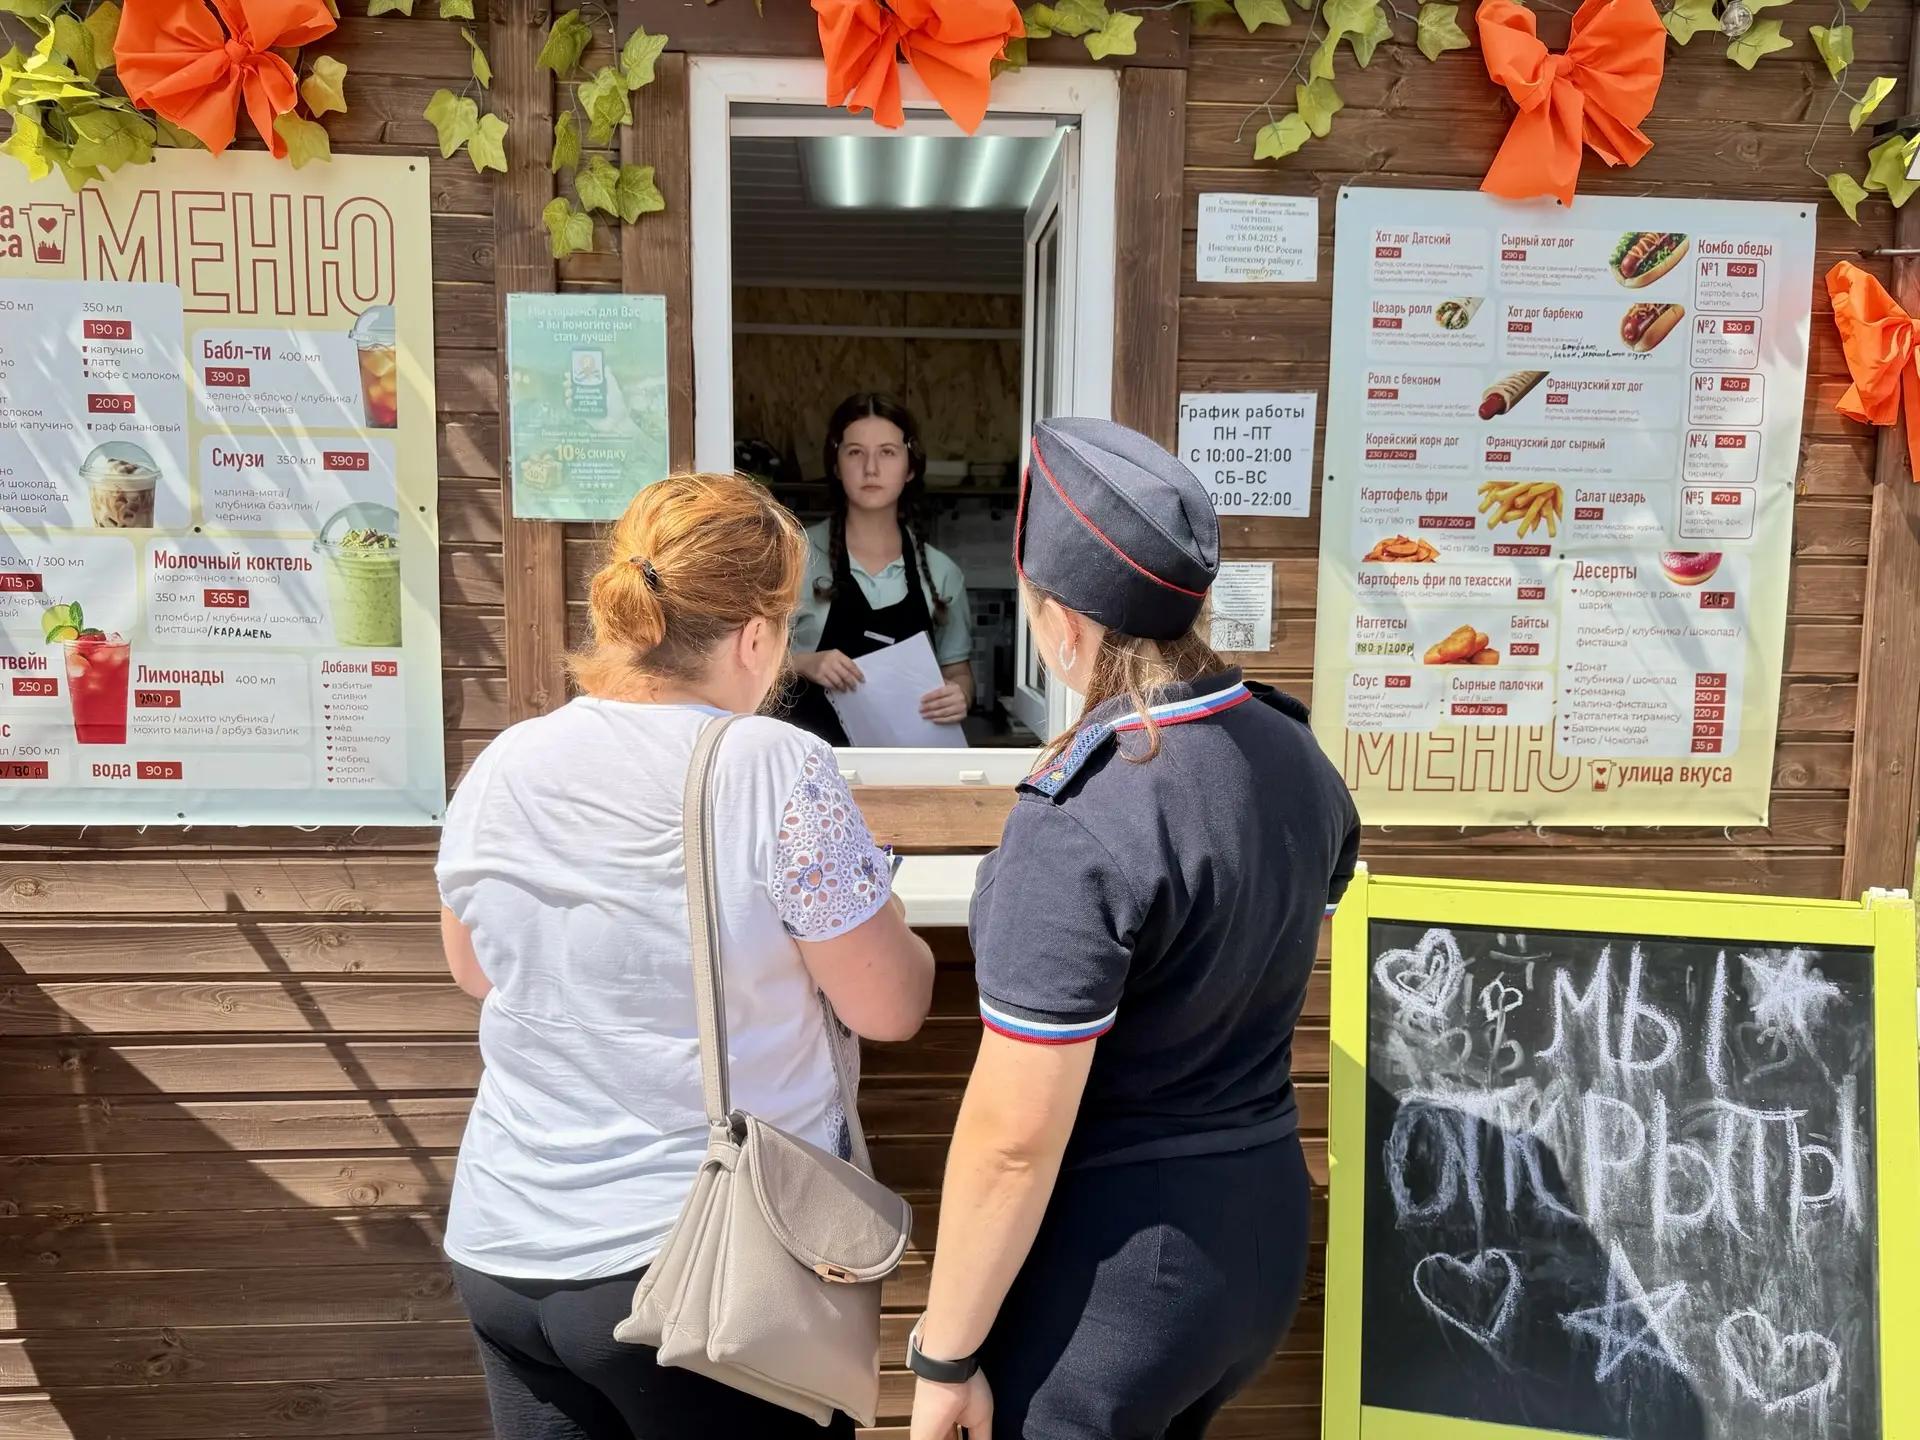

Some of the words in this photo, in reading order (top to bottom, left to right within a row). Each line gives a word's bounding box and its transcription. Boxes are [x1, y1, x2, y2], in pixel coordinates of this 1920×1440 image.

[1375, 230, 1391, 242] Хот
[1411, 232, 1451, 246] Датский
[1501, 233, 1539, 248] Сырный
[1541, 238, 1555, 247] хот
[1558, 238, 1574, 249] дог
[79, 187, 396, 316] МЕНЮ
[1698, 240, 1734, 255] Комбо
[1737, 241, 1773, 257] обеды
[1700, 262, 1719, 277] №1
[1730, 266, 1746, 275] 450
[83, 303, 103, 312] 350
[621, 306, 640, 317] Вас
[1372, 301, 1406, 315] Цезарь
[1408, 305, 1432, 316] ролл
[1507, 305, 1523, 317] Хот
[1525, 309, 1541, 320] дог
[1543, 306, 1583, 322] барбекю
[91, 324, 112, 334] 190
[563, 321, 610, 330] помогите
[1696, 319, 1716, 334] №2
[1726, 322, 1742, 332] 320
[554, 333, 578, 341] стать
[91, 347, 143, 355] капучино
[204, 340, 271, 361] Бабл-ти
[279, 352, 301, 362] 400
[305, 354, 320, 362] мл
[92, 370, 120, 380] кофе
[132, 372, 180, 380] молоком
[211, 372, 233, 382] 390
[1368, 372, 1391, 385] Ролл
[1401, 373, 1441, 385] беконом
[1546, 378, 1610, 393] Французский
[1611, 381, 1626, 391] хот
[1627, 382, 1644, 393] дог
[1694, 376, 1714, 391] №3
[1723, 380, 1739, 389] 420
[254, 392, 292, 402] яблоко
[301, 394, 351, 404] клубника
[96, 399, 119, 409] 200
[206, 405, 239, 413] манго
[248, 406, 294, 415] черника
[1180, 404, 1240, 422] График
[1246, 404, 1305, 422] работы
[21, 422, 73, 431] капучино
[95, 423, 117, 433] раф
[120, 422, 181, 432] банановый
[1213, 426, 1237, 441] ПН
[1366, 433, 1417, 447] Корейский
[1420, 436, 1441, 448] корн
[1444, 436, 1460, 447] дог
[1486, 436, 1549, 450] Французский
[1550, 438, 1566, 450] дог
[1569, 438, 1606, 452] сырный
[1689, 434, 1708, 448] №4
[1718, 437, 1734, 446] 260
[212, 448, 264, 472] Смузи
[277, 456, 297, 465] 350
[300, 457, 316, 465] мл
[587, 449, 626, 461] скидку
[1190, 448, 1201, 463] С
[1206, 448, 1293, 463] 10:00-21:00
[330, 456, 353, 466] 390
[1214, 470, 1268, 484] СБ-ВС
[8, 481, 56, 489] шоколад
[21, 494, 69, 502] шоколад
[214, 488, 286, 498] малина-мята
[1360, 487, 1423, 504] Картофель
[1425, 488, 1448, 505] фри
[1575, 488, 1606, 503] Салат
[1608, 491, 1646, 506] цезарь
[1685, 491, 1704, 505] №5
[1714, 494, 1730, 503] 470
[1210, 492, 1292, 506] 0:00-22:00
[215, 501, 266, 511] клубника
[268, 501, 313, 511] базилик
[216, 513, 262, 523] черника
[19, 558, 33, 566] мл
[43, 557, 65, 566] 300
[154, 550, 240, 570] Молочный
[247, 557, 312, 571] коктель
[1573, 560, 1637, 583] Десерты
[1357, 571, 1419, 589] Картофель
[1423, 572, 1446, 589] фри
[1465, 575, 1512, 587] техасски
[156, 593, 176, 602] 350
[180, 594, 195, 602] мл
[211, 593, 235, 604] 365
[1579, 589, 1648, 599] Мороженное
[1659, 591, 1692, 600] рожке
[1579, 602, 1613, 612] шарик
[155, 614, 203, 623] пломбир
[213, 615, 261, 624] клубника
[270, 616, 317, 624] шоколад
[1356, 615, 1407, 629] Наггетсы
[1511, 615, 1549, 629] Байтсы
[1577, 626, 1624, 636] пломбир
[1632, 626, 1681, 637] клубника
[1689, 627, 1735, 637] шоколад
[1576, 638, 1628, 648] фисташка
[321, 660, 368, 675] Добавки
[374, 664, 387, 673] 50
[1574, 663, 1607, 673] Донат
[137, 665, 224, 686] Лимонады
[235, 676, 257, 685] 400
[260, 677, 276, 685] мл
[1574, 674, 1624, 685] клубника
[1632, 676, 1677, 685] шоколад
[19, 682, 40, 692] 250
[1352, 673, 1379, 690] Соус
[1452, 677, 1496, 692] Сырные
[1499, 679, 1544, 691] палочки
[1572, 700, 1668, 710] малина-фисташка
[133, 715, 171, 723] мохито
[179, 715, 216, 723] мохито
[220, 714, 268, 724] клубника
[1572, 712, 1629, 721] Тарталетка
[1632, 713, 1682, 722] тирамису
[134, 727, 171, 735] мохито
[222, 726, 252, 736] арбуз
[255, 726, 299, 735] базилик
[1571, 725, 1620, 733] Батончик
[1571, 736, 1597, 745] Трио
[1604, 736, 1649, 745] Чокопай
[19, 747, 41, 755] 500
[93, 764, 131, 779] вода
[146, 766, 161, 775] 90
[1617, 765, 1674, 788] улица
[1679, 766, 1732, 788] вкуса
